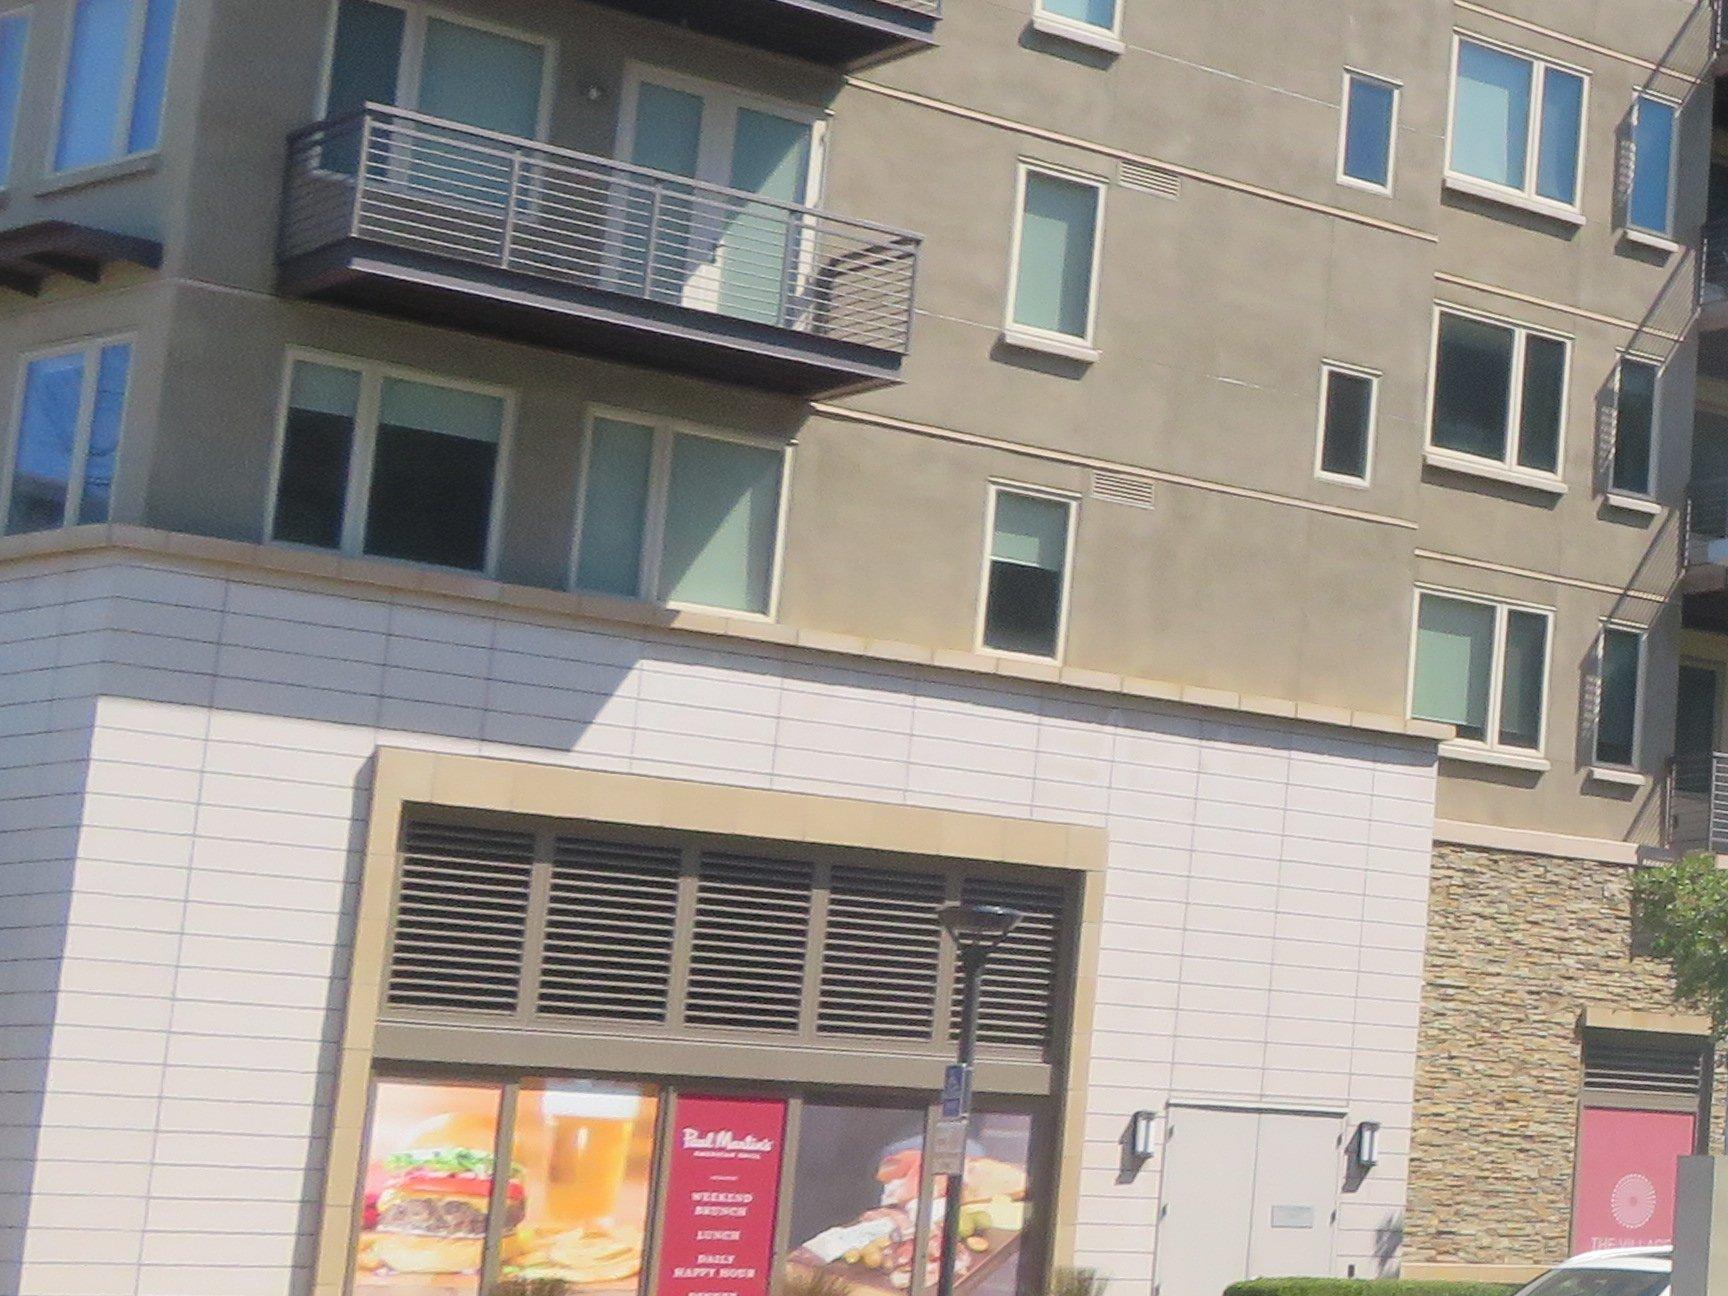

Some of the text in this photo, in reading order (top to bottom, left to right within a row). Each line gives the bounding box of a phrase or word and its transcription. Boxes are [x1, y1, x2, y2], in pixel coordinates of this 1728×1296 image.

[682, 1127, 714, 1149] Paul
[691, 1192, 754, 1203] WEEKEND
[694, 1205, 748, 1217] BRUNCH
[696, 1230, 741, 1241] LUNCH
[697, 1254, 736, 1265] DAILY
[673, 1267, 756, 1279] HAPPY HOUR
